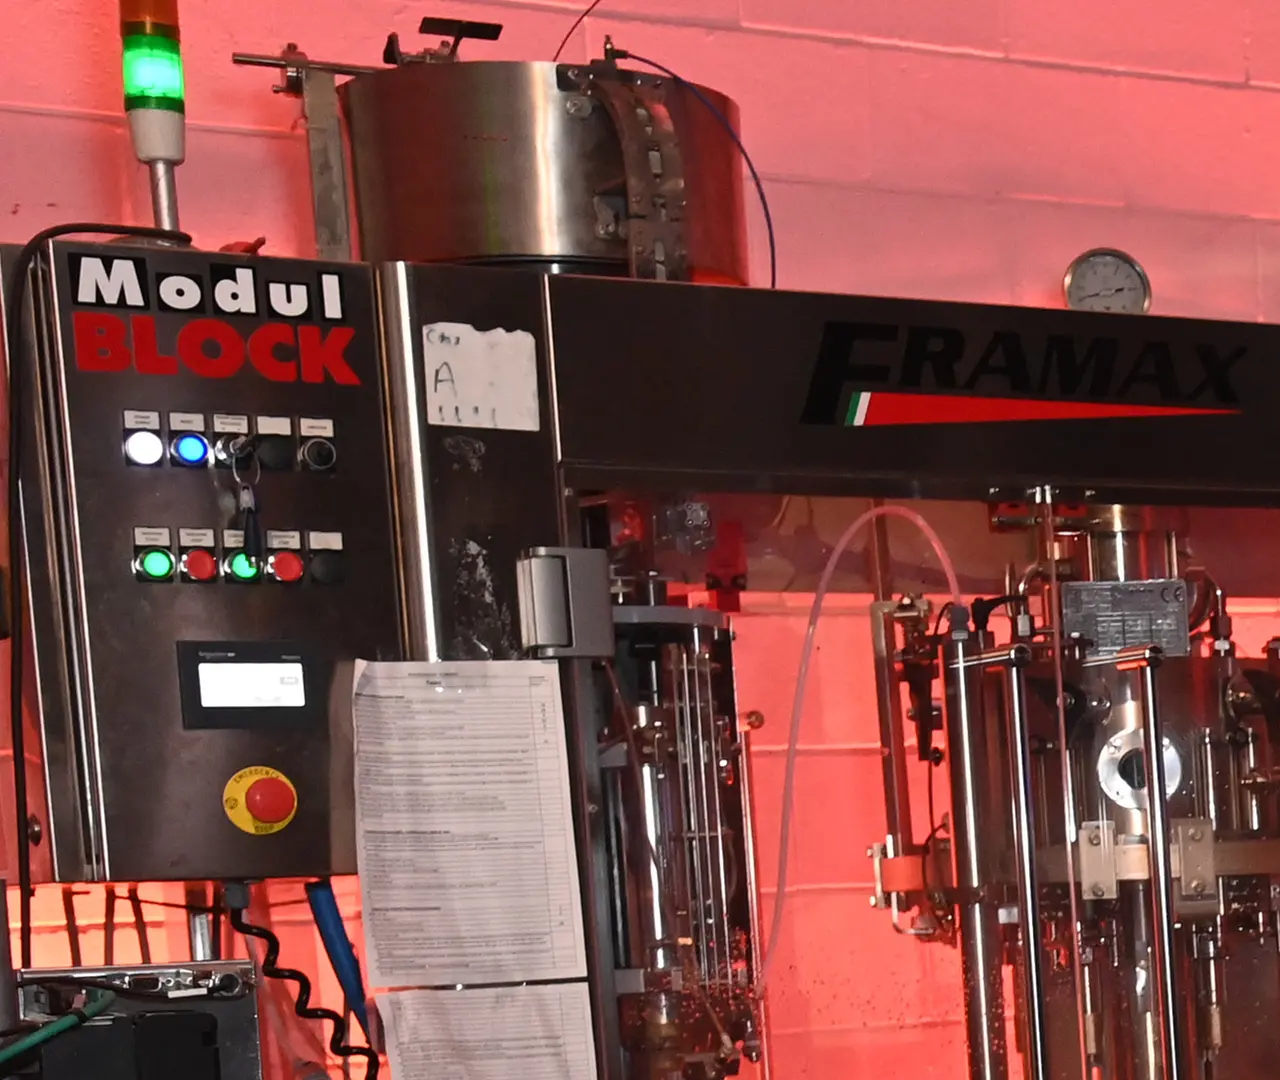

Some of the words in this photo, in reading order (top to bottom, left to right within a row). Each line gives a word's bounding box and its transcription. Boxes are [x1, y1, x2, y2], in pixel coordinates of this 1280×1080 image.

[77, 256, 343, 320] Modul
[72, 311, 362, 386] BLOCK
[800, 320, 1250, 426] FRAMAX
